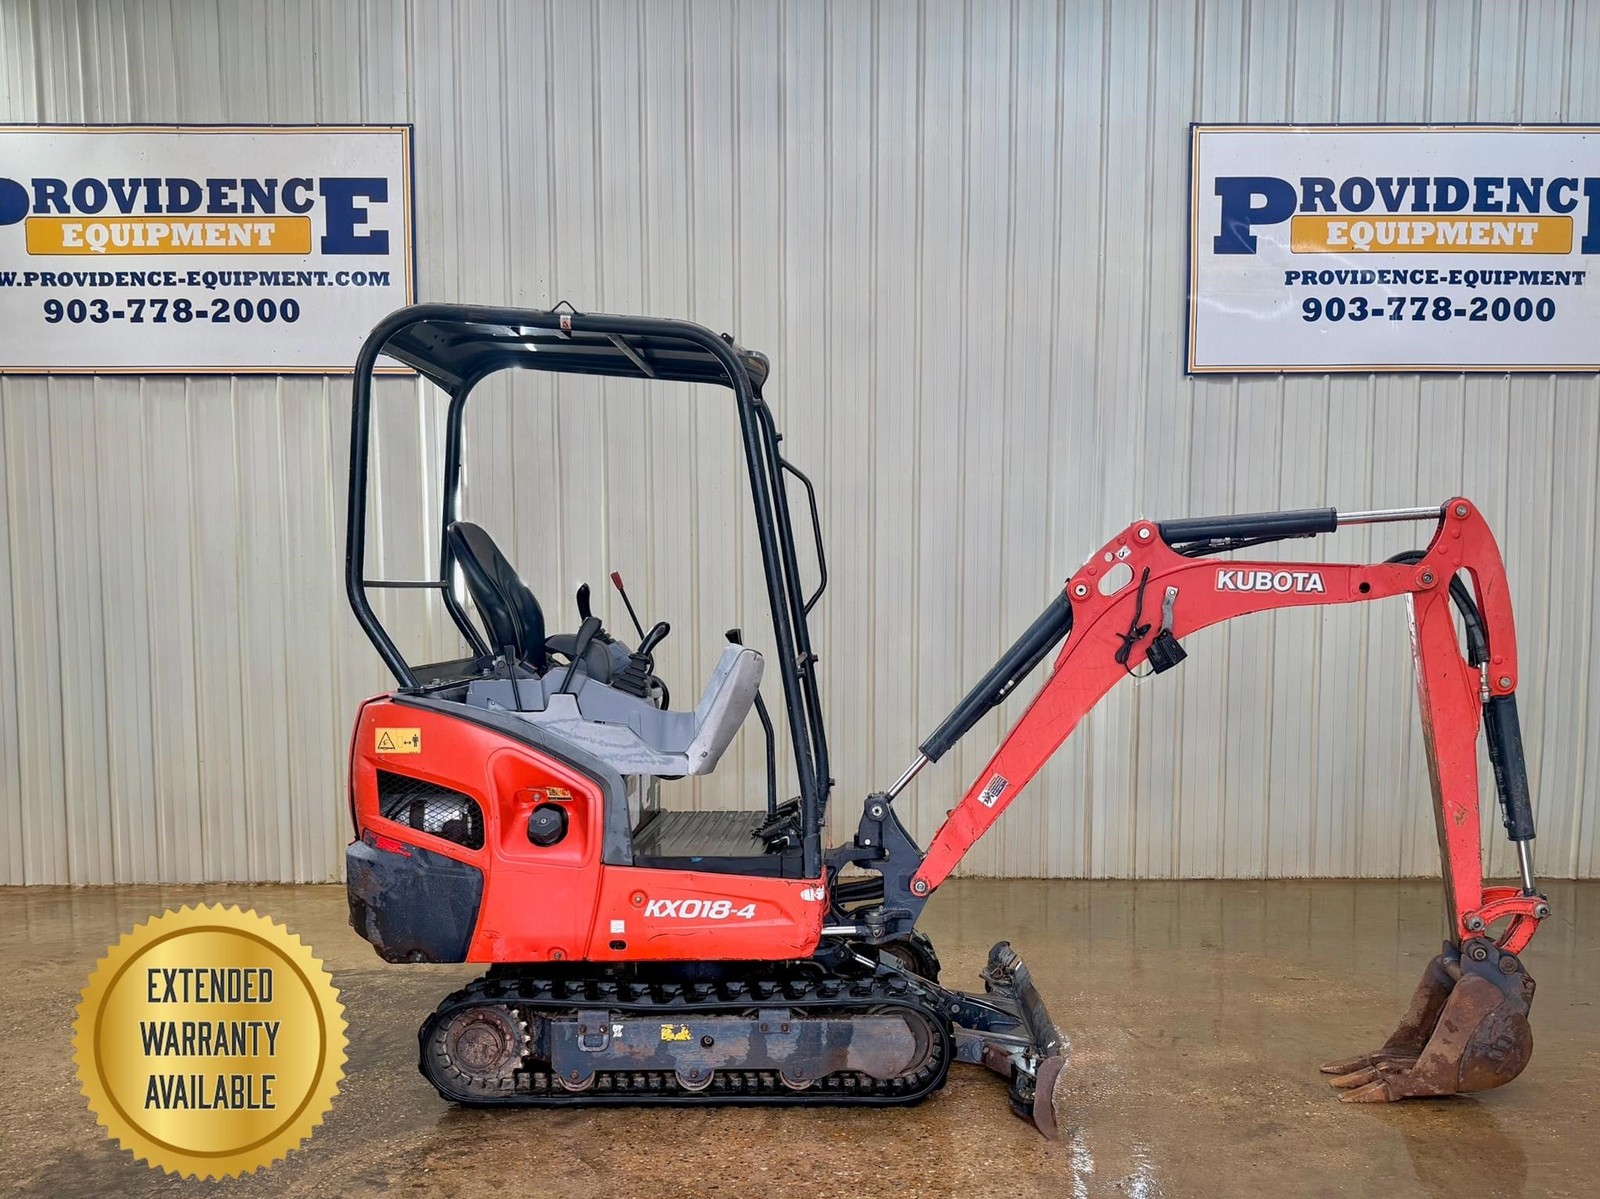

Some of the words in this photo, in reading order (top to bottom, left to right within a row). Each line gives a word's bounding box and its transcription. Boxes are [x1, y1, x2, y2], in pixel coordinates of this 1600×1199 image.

[1214, 177, 1600, 254] PROVIDENC
[62, 223, 275, 253] EQUIPMENT
[1326, 221, 1538, 250] EQUIPMENT
[1284, 270, 1585, 288] PROVIDENCE-EQUIPMENT
[43, 298, 300, 323] 903-778-2000
[1302, 297, 1555, 321] 903-778-2000
[1217, 571, 1324, 592] KUBOTA
[644, 900, 755, 919] KX018-4
